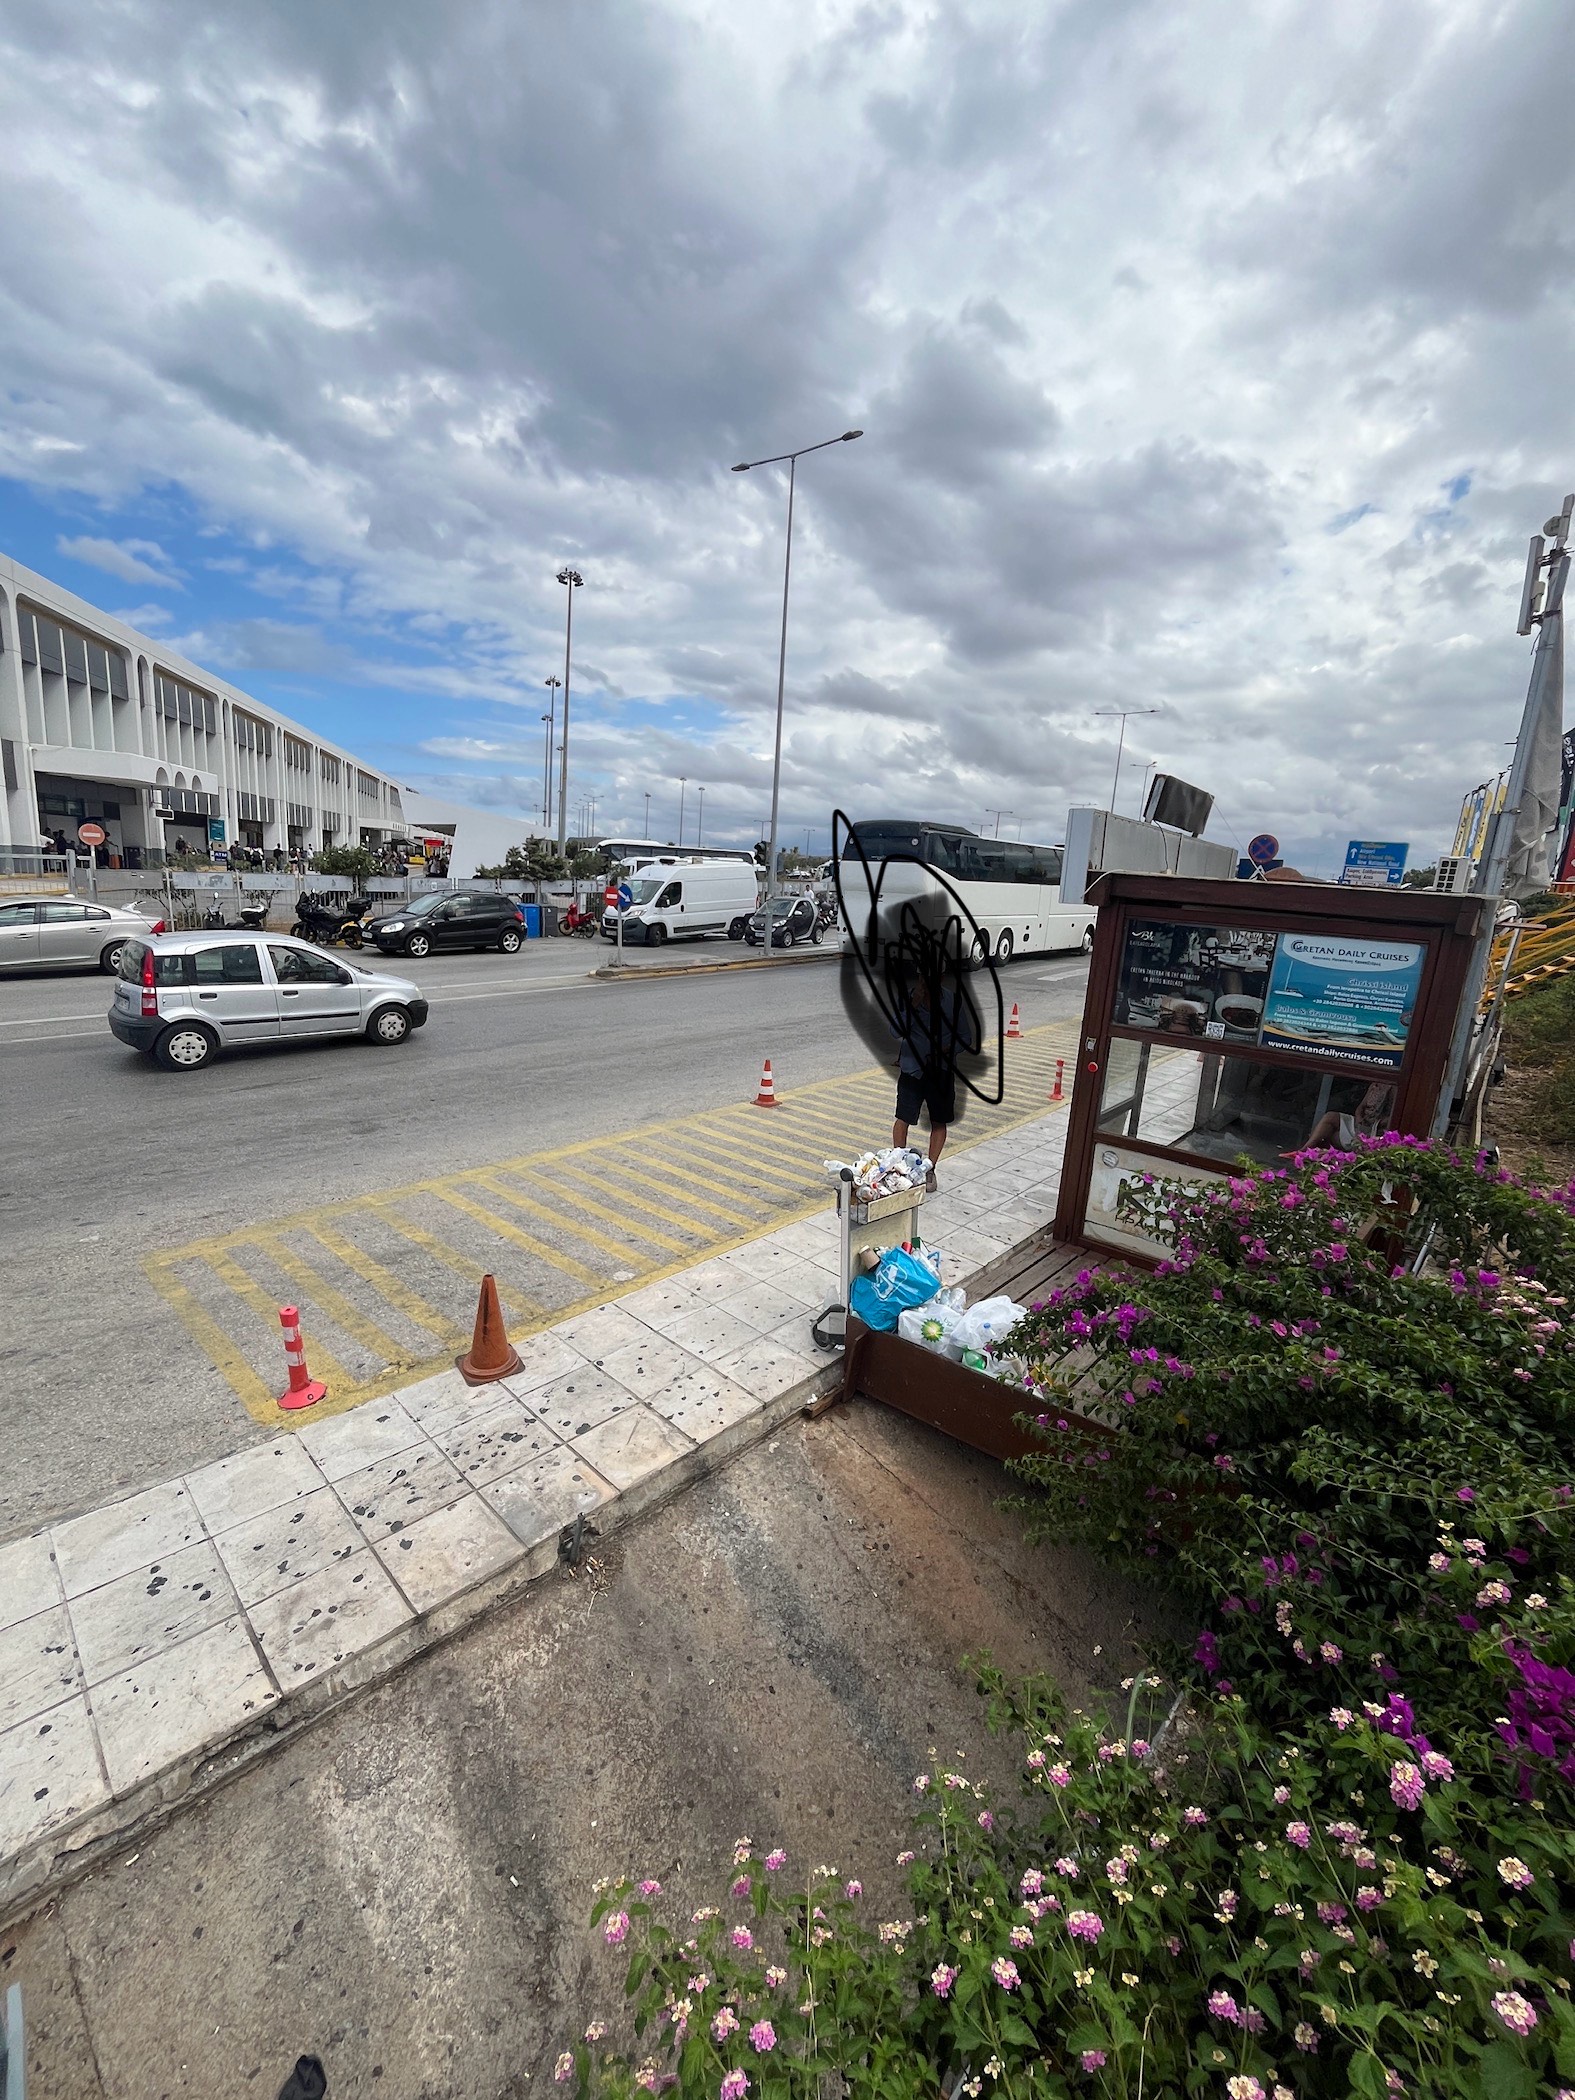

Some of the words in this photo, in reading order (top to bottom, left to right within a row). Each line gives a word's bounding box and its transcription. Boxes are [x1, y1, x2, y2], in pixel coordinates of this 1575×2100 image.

[1291, 940, 1334, 954] CRETAN
[1339, 949, 1366, 959] DAILY
[1369, 952, 1410, 962] CRUISES
[1268, 1040, 1393, 1066] www.cretandailycruises.com
